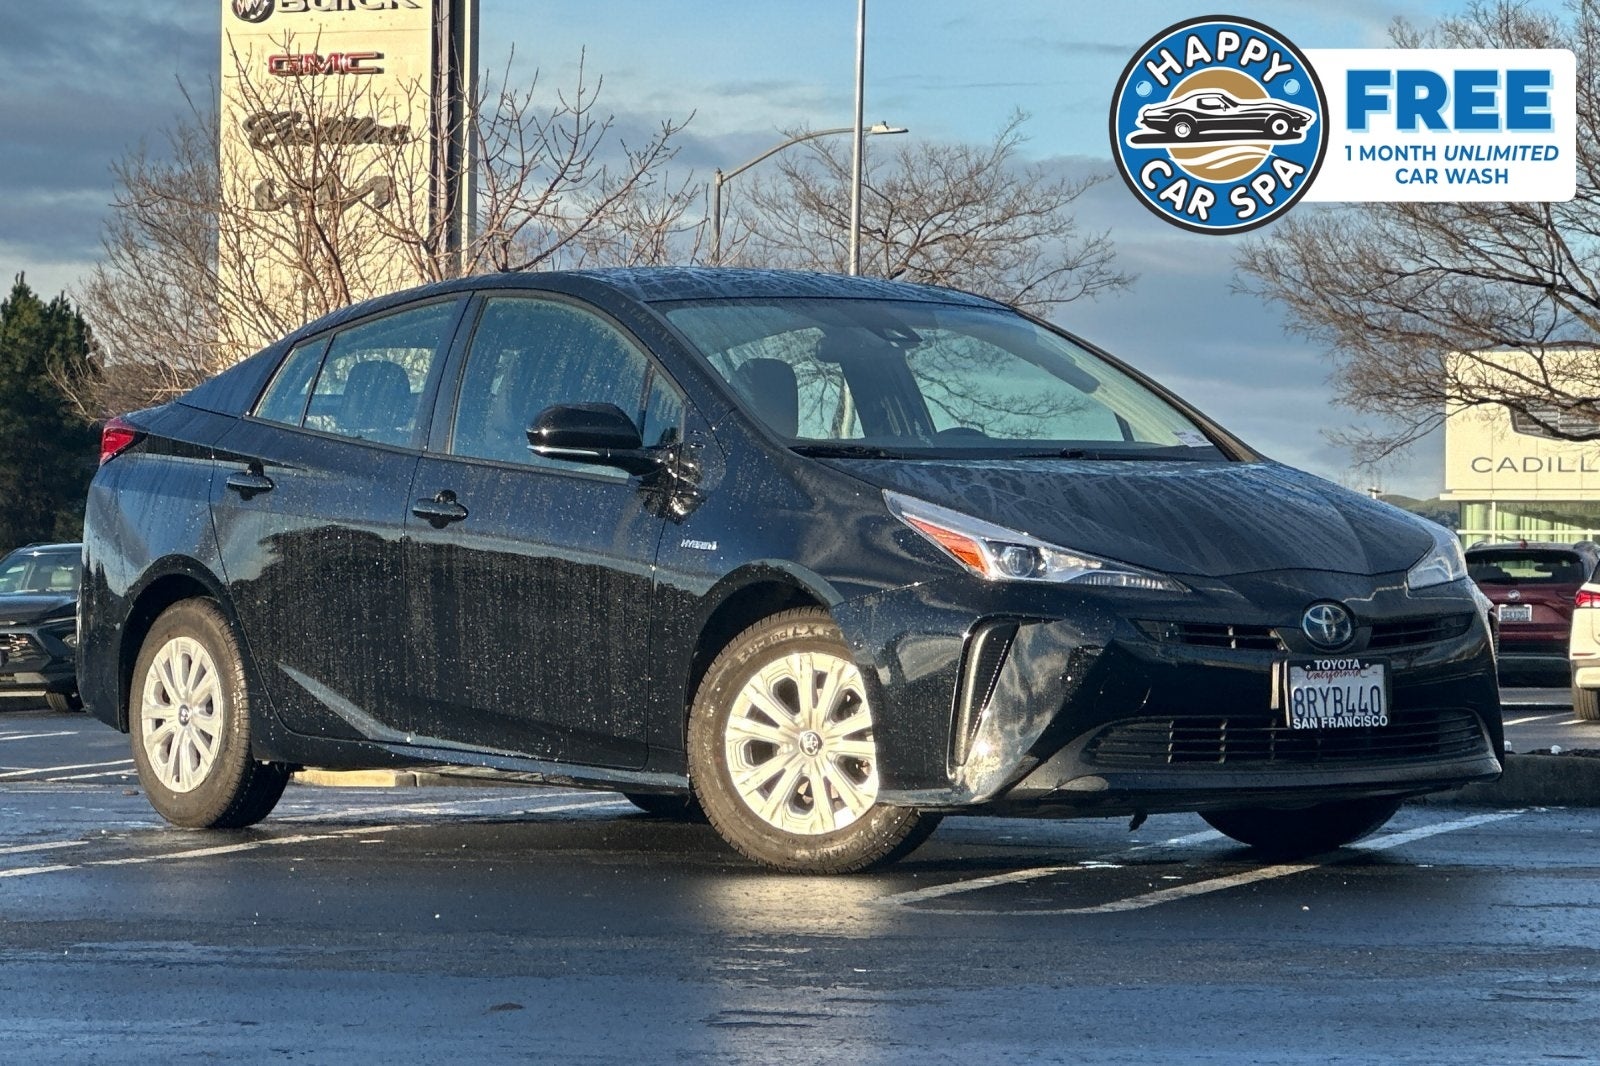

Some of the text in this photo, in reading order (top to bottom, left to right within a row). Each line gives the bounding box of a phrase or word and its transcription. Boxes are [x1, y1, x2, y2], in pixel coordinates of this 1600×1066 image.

[268, 51, 384, 76] GMC
[1471, 456, 1600, 473] CADILL
[1314, 659, 1360, 670] TOYOTA
[1306, 669, 1361, 683] California
[1293, 685, 1381, 719] 8RYB440
[1293, 715, 1388, 729] SAN FRANCISCO
